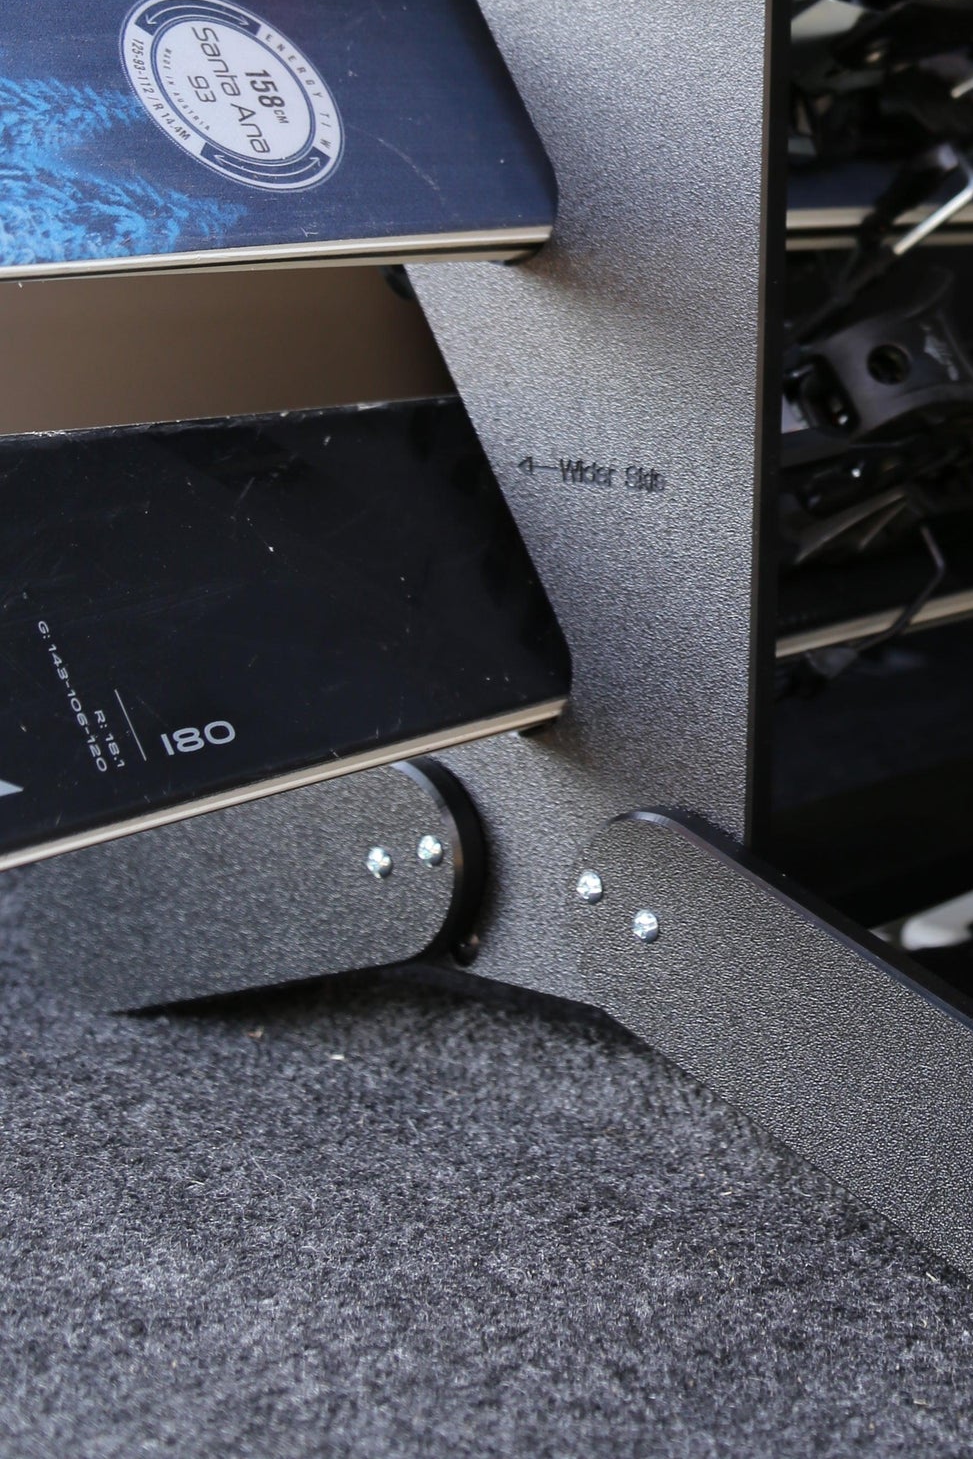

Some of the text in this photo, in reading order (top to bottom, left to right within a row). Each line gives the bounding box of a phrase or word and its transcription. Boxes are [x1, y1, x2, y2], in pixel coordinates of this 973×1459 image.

[162, 48, 173, 70] MADE
[173, 92, 211, 131] AUSTRIA
[186, 75, 217, 103] 93
[191, 26, 271, 154] Santa Ana
[265, 33, 323, 99] ENERGY
[38, 620, 107, 772] G: 143-106-120
[94, 709, 125, 768] R: 18.1
[160, 720, 236, 756] 180
